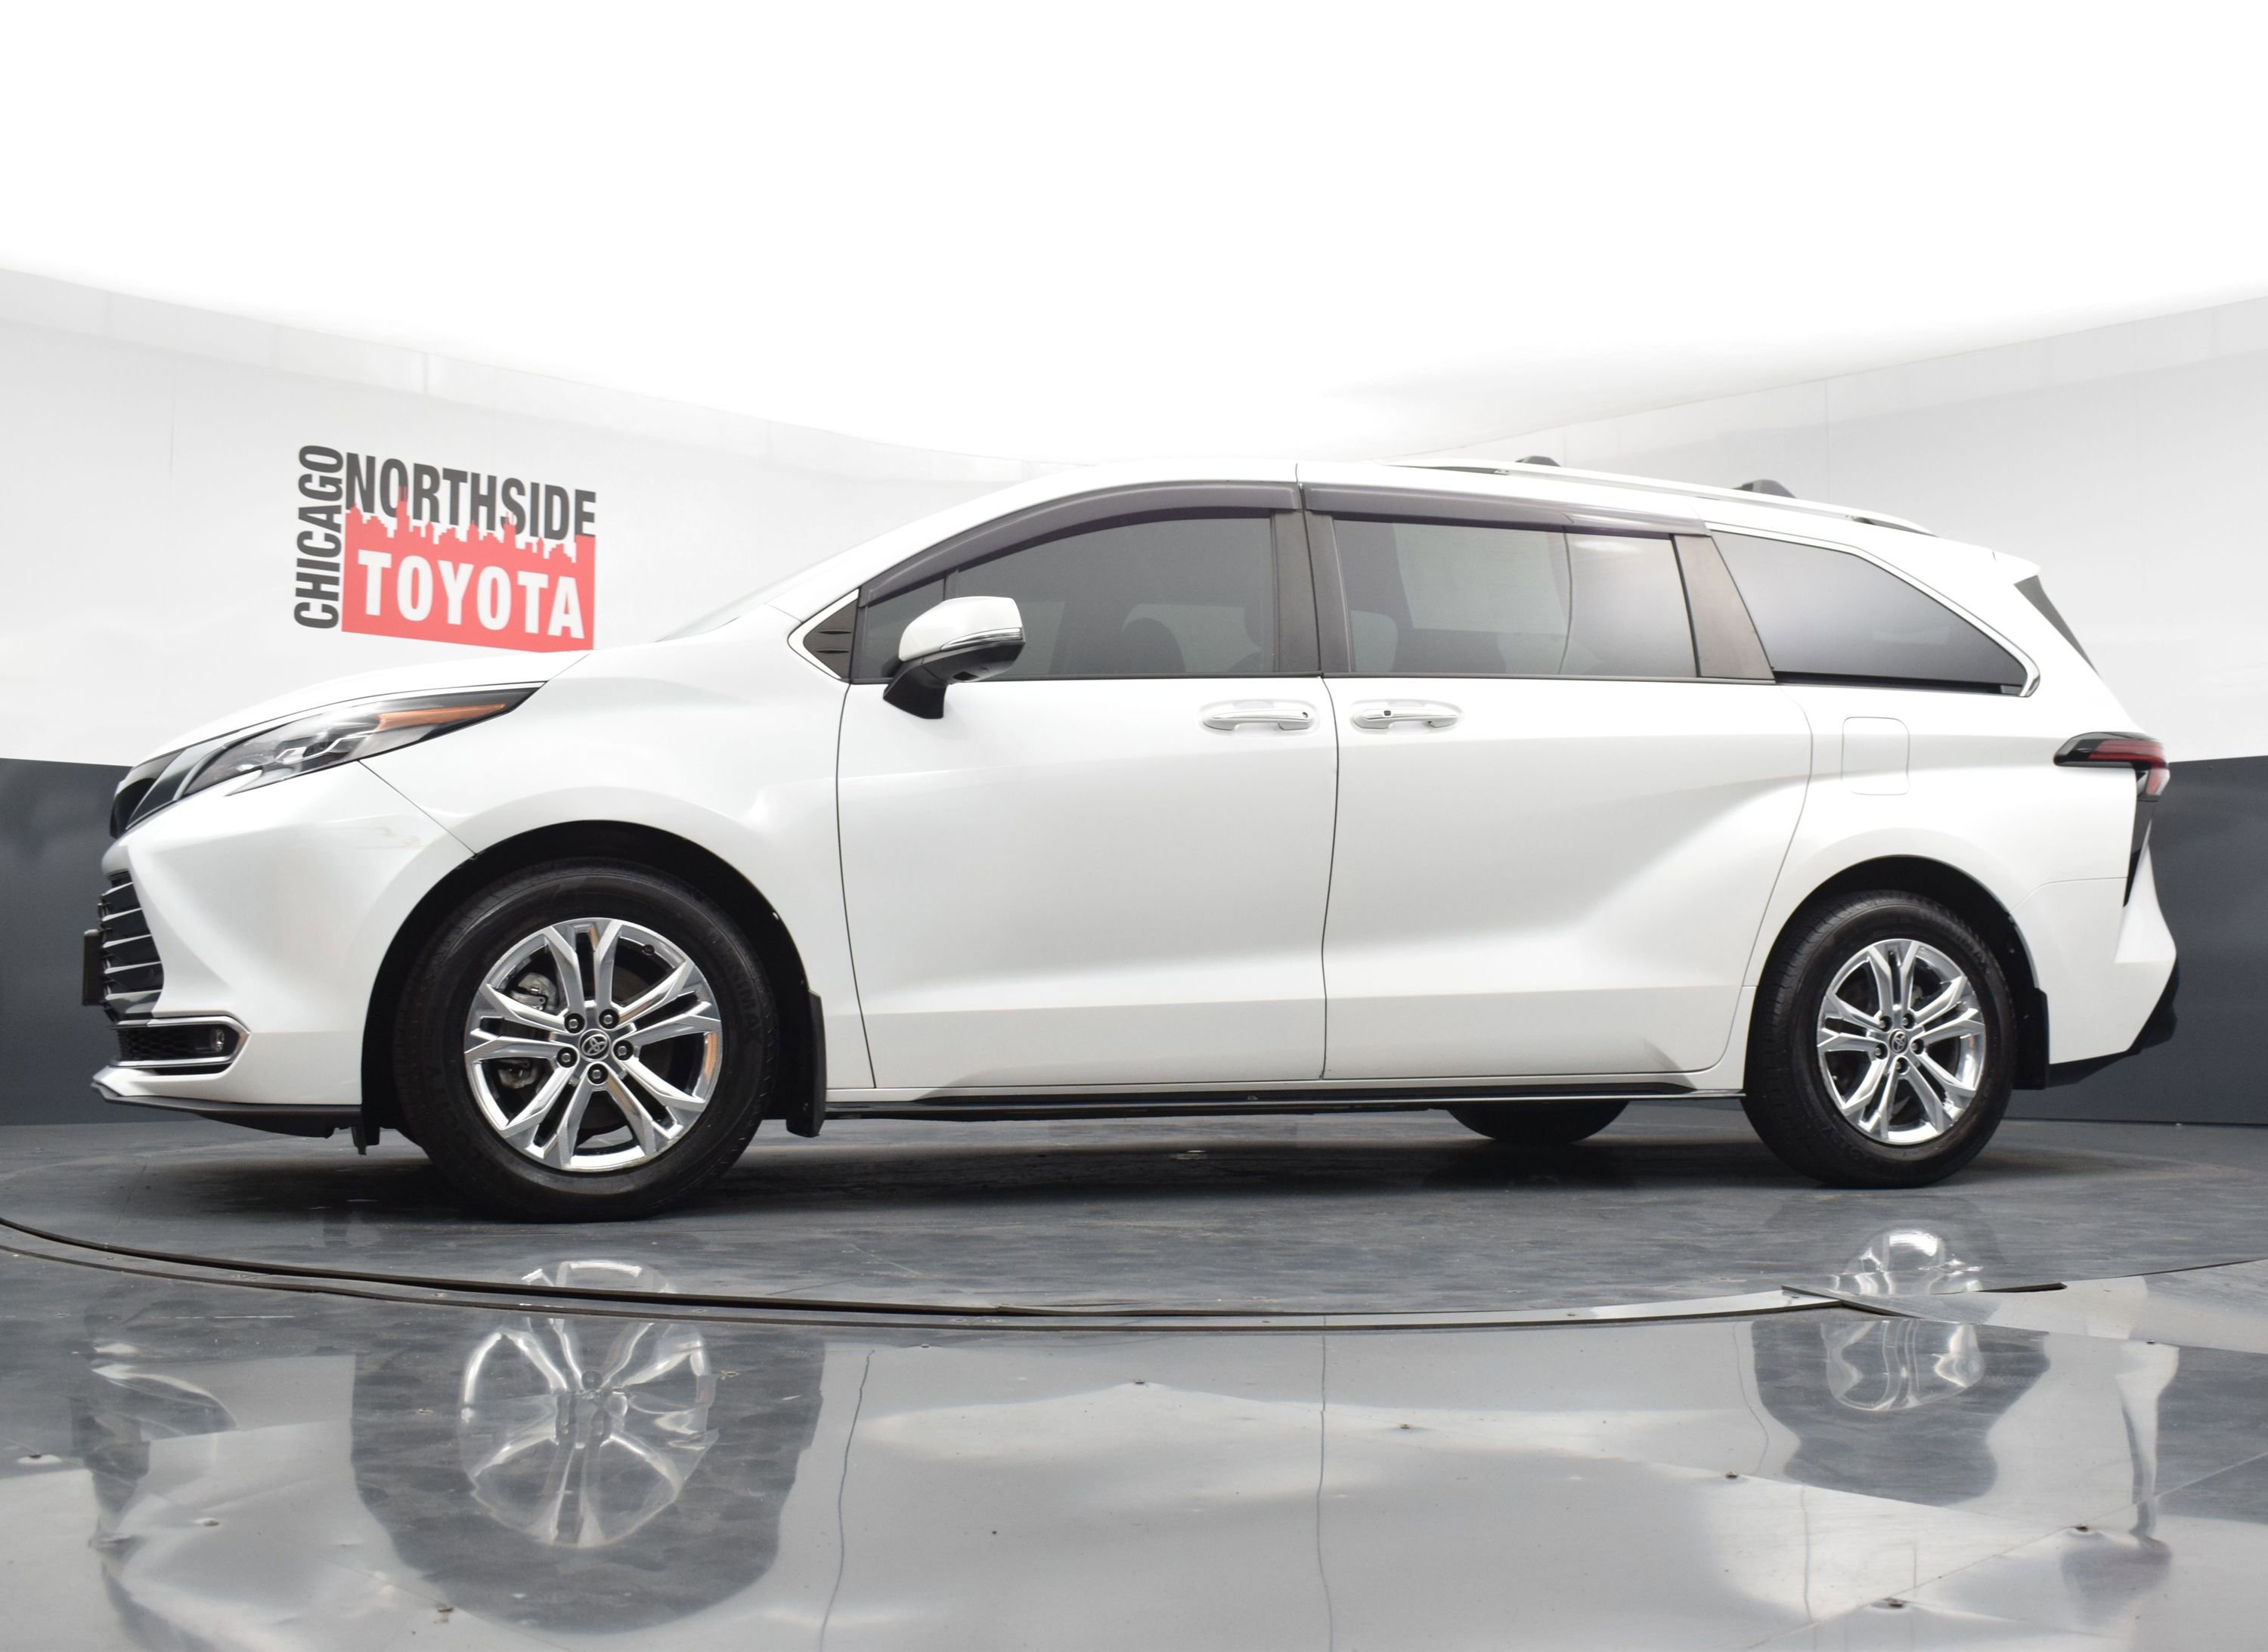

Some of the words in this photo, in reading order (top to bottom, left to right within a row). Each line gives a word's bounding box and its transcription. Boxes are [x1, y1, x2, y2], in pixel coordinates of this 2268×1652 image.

[293, 445, 345, 629] CHICAGO
[345, 451, 596, 541] NORTHSIDE
[358, 549, 585, 640] TOYOTA
